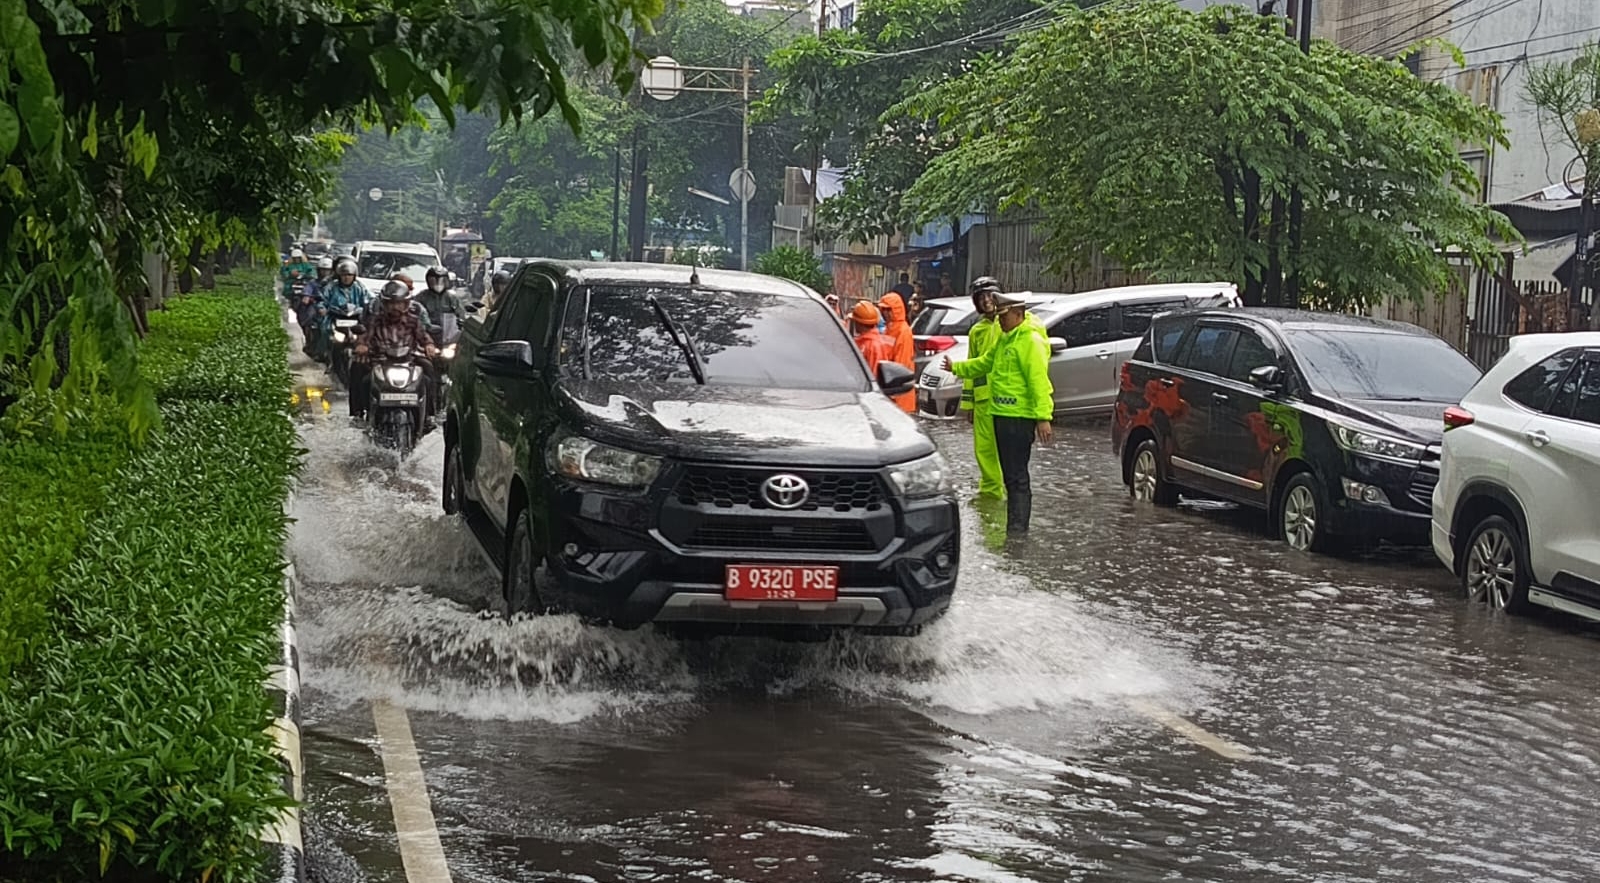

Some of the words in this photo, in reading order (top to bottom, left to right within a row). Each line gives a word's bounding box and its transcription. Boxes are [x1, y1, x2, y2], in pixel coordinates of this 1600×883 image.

[727, 569, 740, 588] B
[748, 569, 793, 589] 9320
[802, 569, 835, 589] PSE
